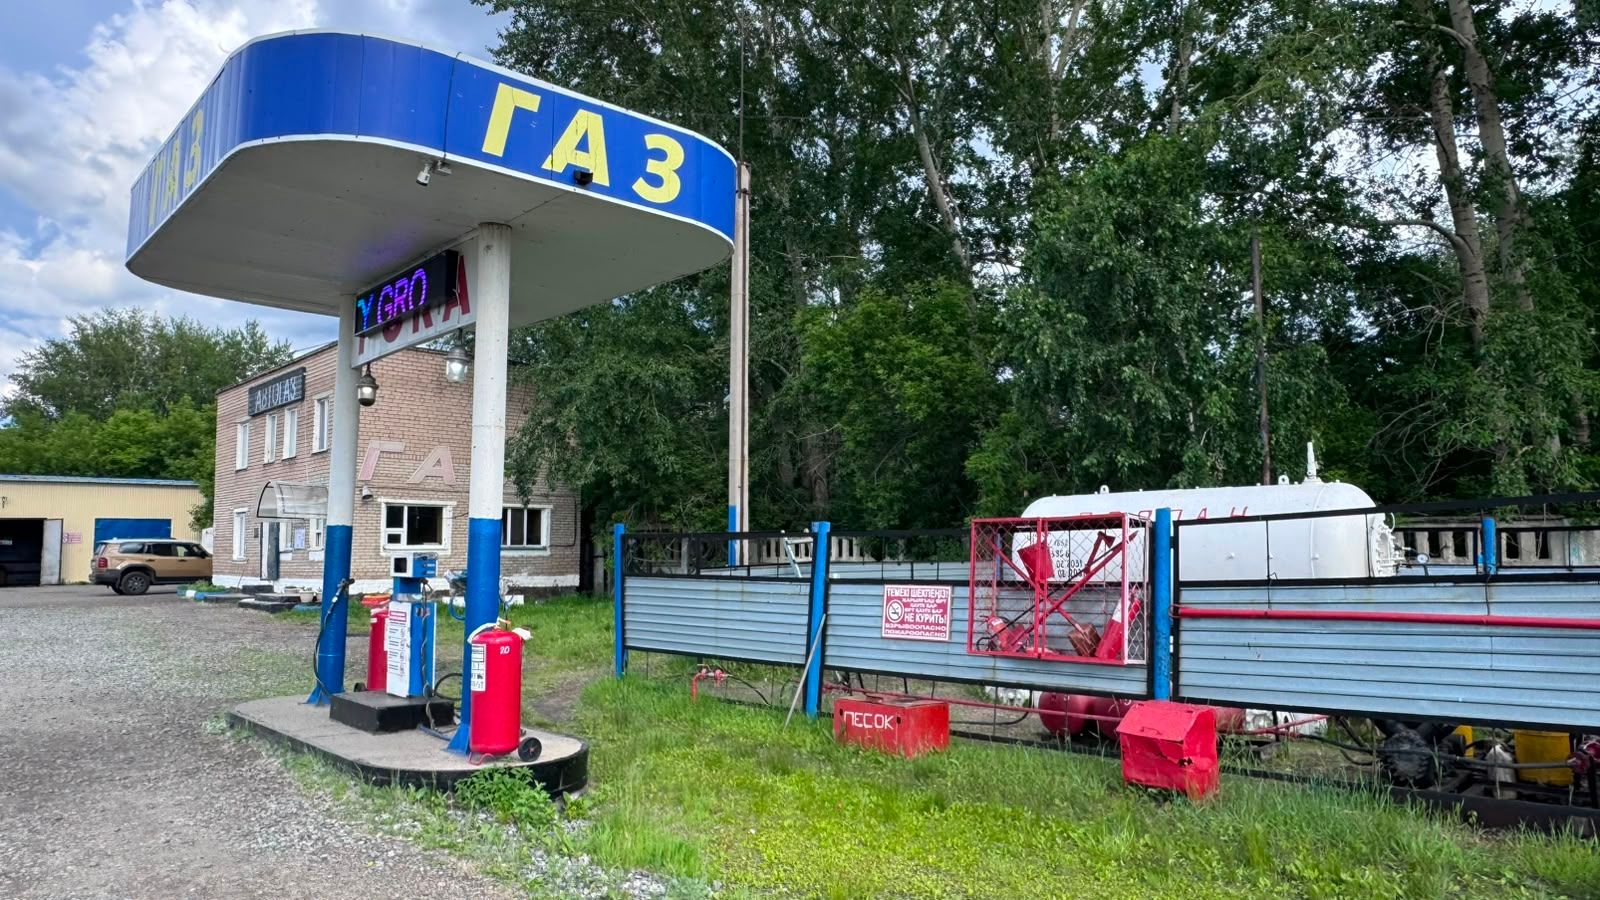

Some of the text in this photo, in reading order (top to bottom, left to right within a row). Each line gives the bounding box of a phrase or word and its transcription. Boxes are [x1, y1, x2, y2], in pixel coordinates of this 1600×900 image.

[481, 82, 685, 204] ГАЗ
[904, 613, 914, 622] НЕ
[499, 645, 511, 655] 20
[843, 710, 895, 731] ПЕСОК
